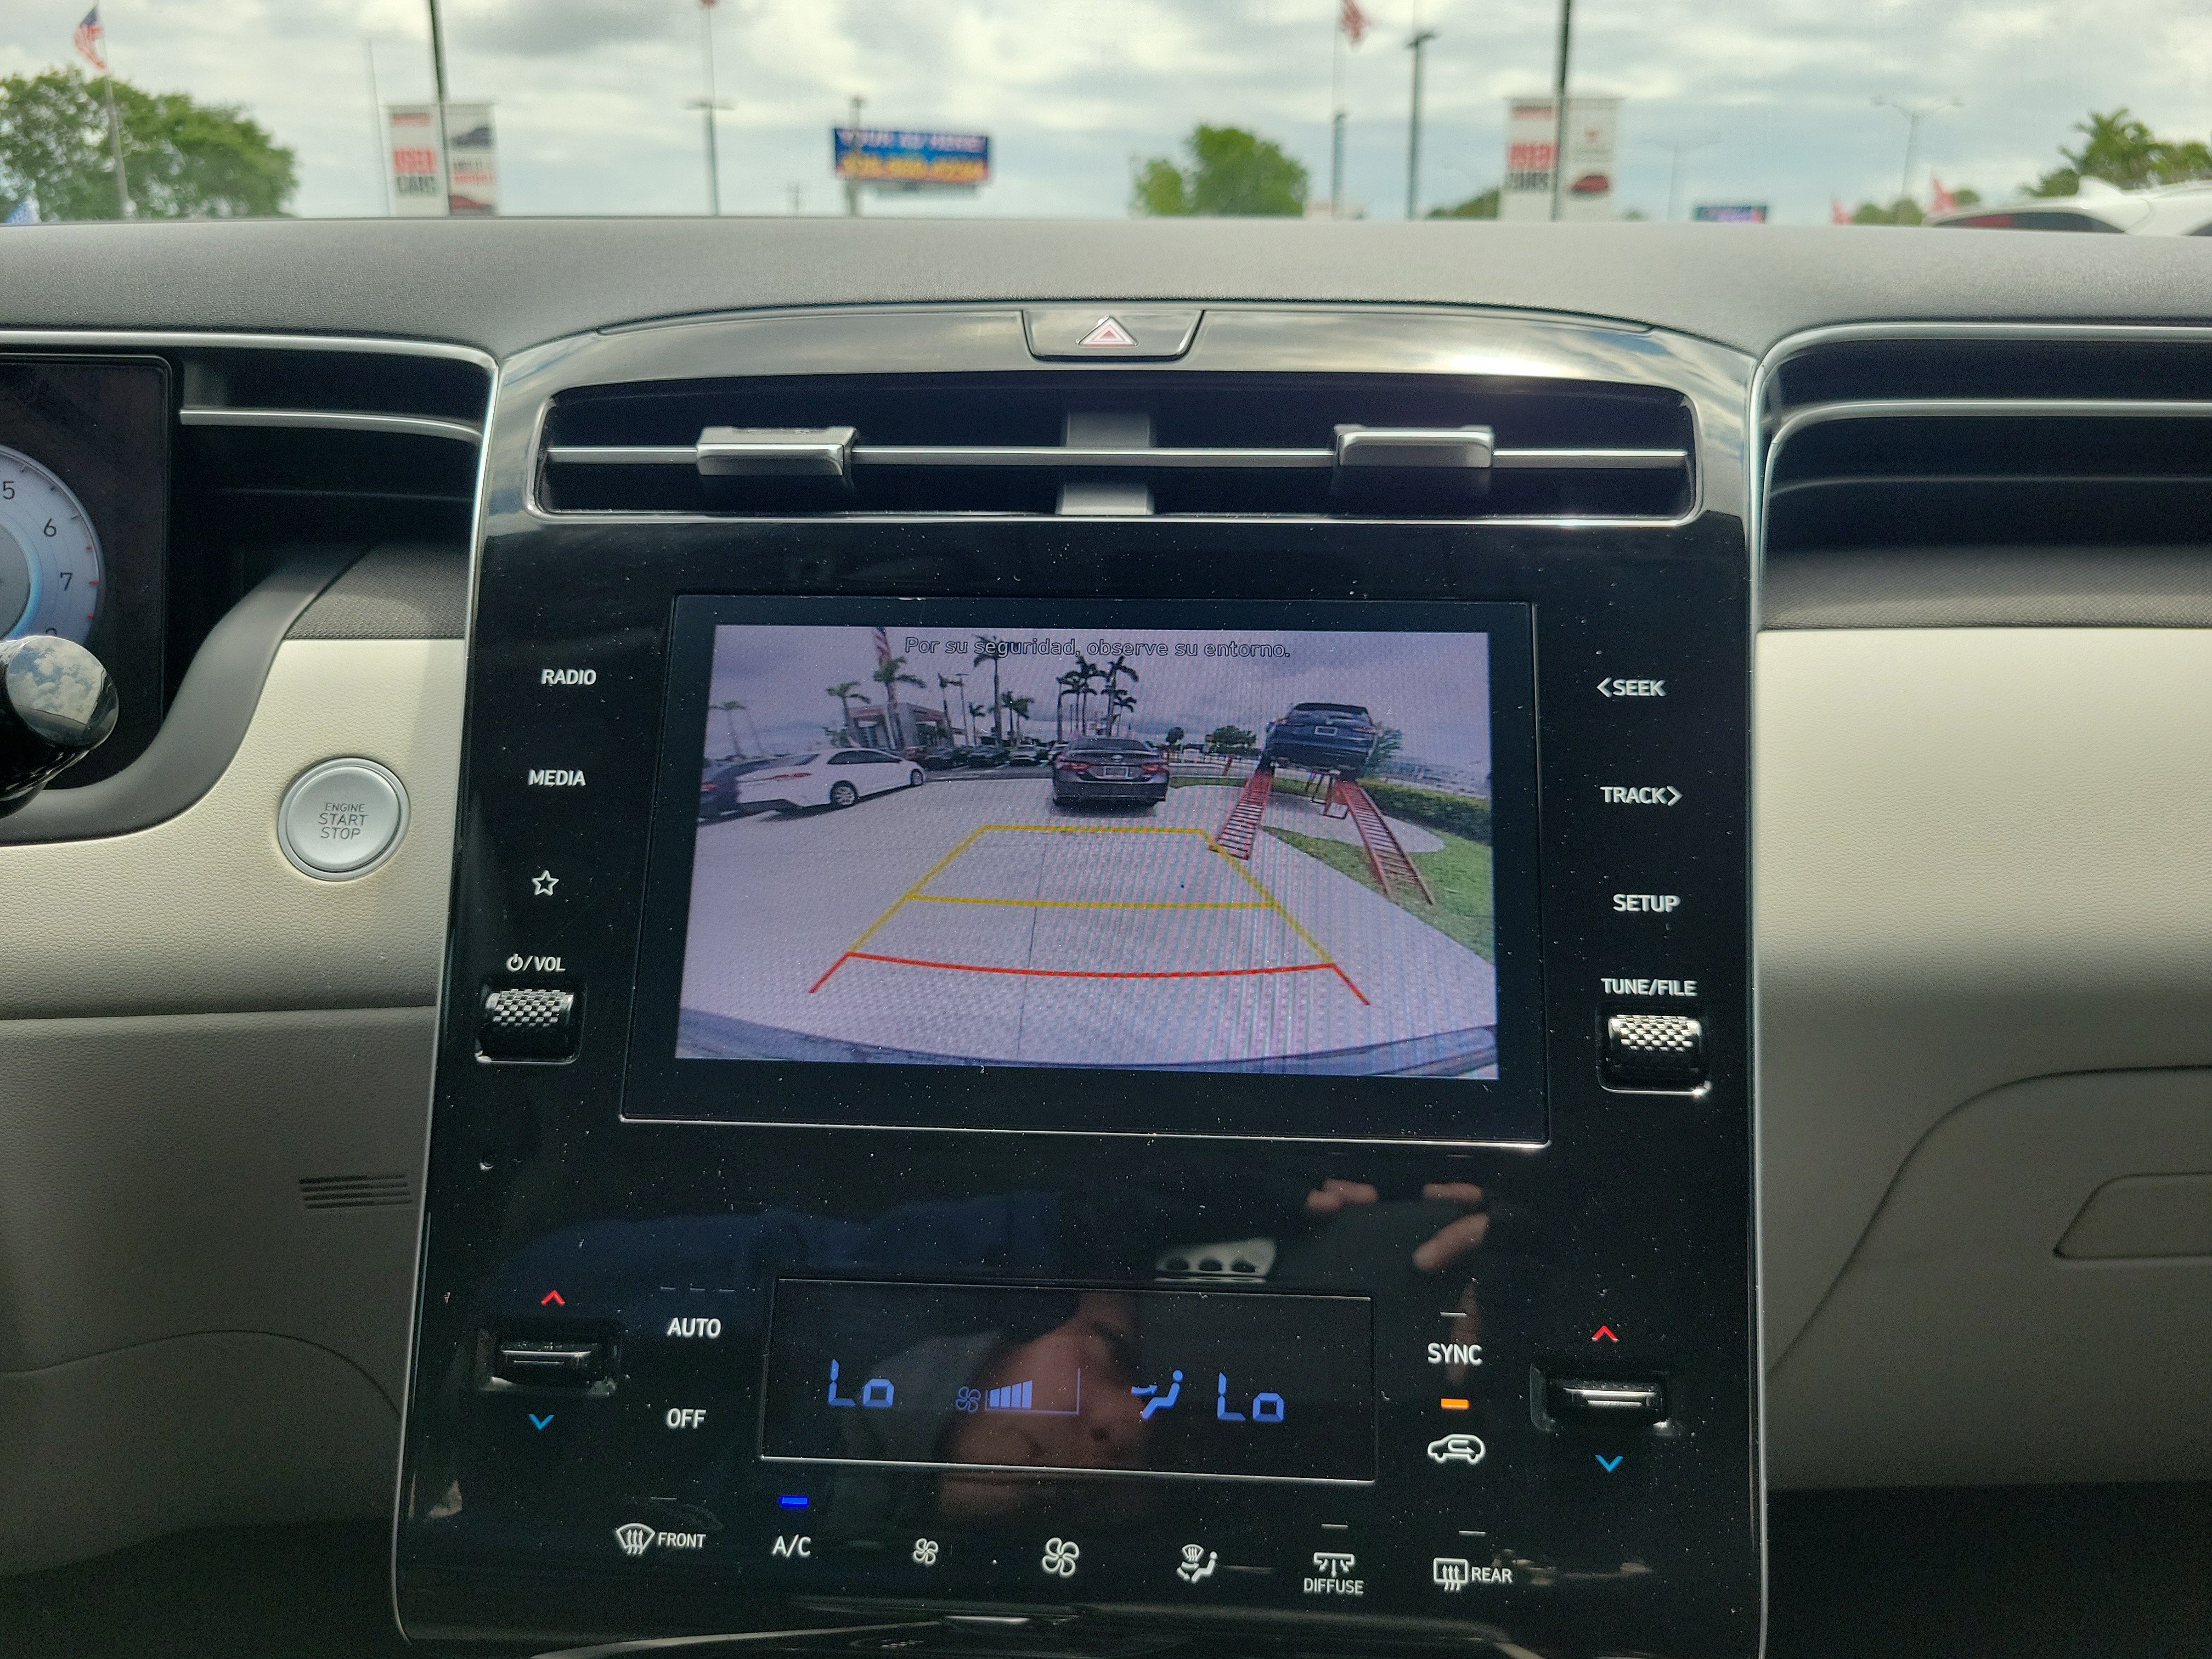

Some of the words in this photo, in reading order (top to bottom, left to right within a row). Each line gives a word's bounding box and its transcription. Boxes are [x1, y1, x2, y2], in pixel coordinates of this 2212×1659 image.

[2, 481, 15, 500] 5
[43, 518, 57, 537] 6
[60, 572, 73, 591] 7
[905, 636, 940, 654] Por
[945, 640, 968, 655] su
[974, 637, 1081, 657] seguridad,
[1087, 639, 1168, 656] observe
[1174, 642, 1198, 657] su
[1204, 641, 1290, 658] entorno.
[541, 669, 597, 685] RADIO
[528, 769, 586, 787] MEDIA
[325, 802, 366, 812] ENGINE
[318, 812, 368, 826] START
[320, 827, 361, 840] STOP
[1613, 894, 1680, 913] SETUP
[1600, 978, 1697, 997] TUNE/FILE
[666, 1317, 721, 1339] AUTO
[1427, 1342, 1483, 1365] SYNC
[827, 1358, 895, 1409] Lo
[1217, 1372, 1285, 1423] Lo
[666, 1408, 707, 1429] OFF
[657, 1532, 706, 1548] FRONT
[771, 1534, 812, 1557] A/C
[1471, 1566, 1513, 1583] REAR
[1304, 1577, 1364, 1595] DIFFUSE
